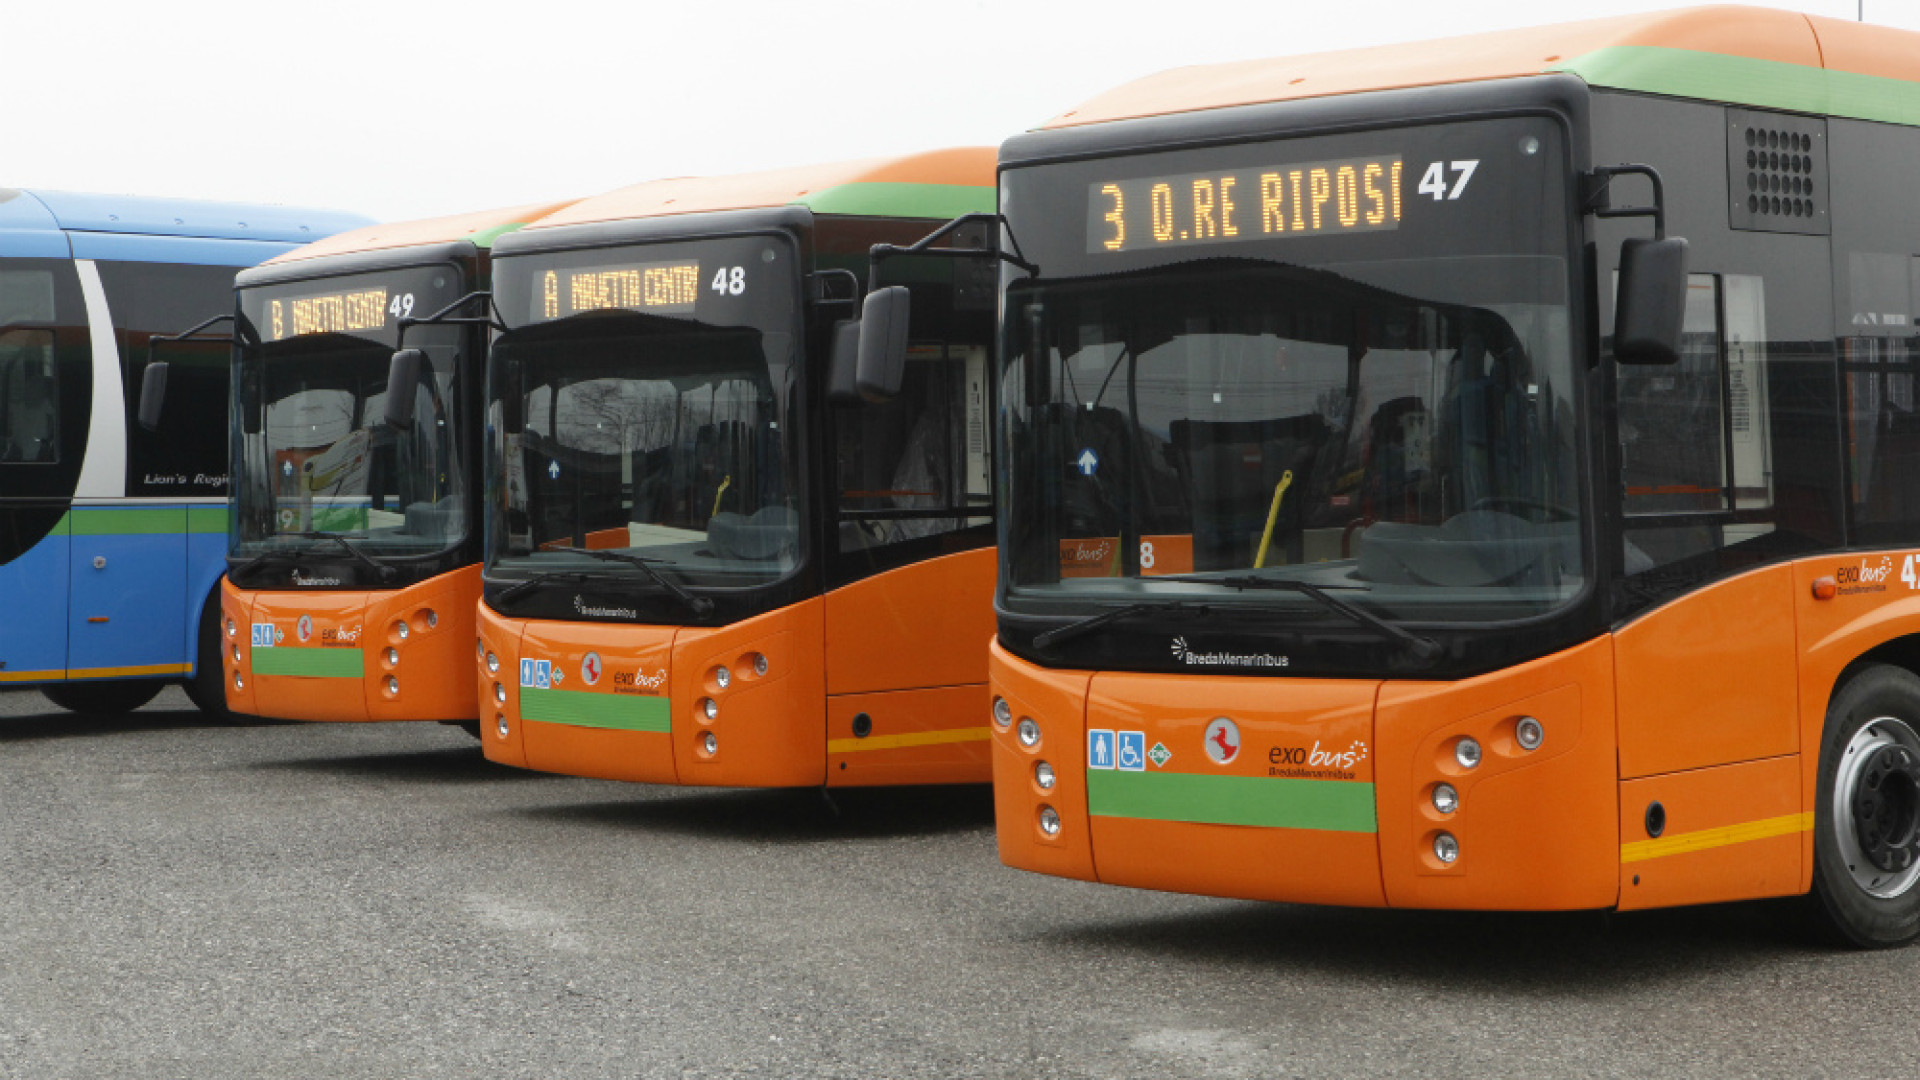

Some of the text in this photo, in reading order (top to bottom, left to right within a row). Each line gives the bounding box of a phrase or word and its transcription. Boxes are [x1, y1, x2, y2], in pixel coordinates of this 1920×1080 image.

[1418, 158, 1480, 201] 47
[1102, 183, 1125, 251] 3
[544, 269, 558, 318] A
[644, 265, 699, 306] CENTR
[711, 265, 746, 297] 48
[389, 292, 415, 319] 49
[143, 473, 187, 485] Lion's
[1186, 652, 1290, 667] BredaMenarinibus
